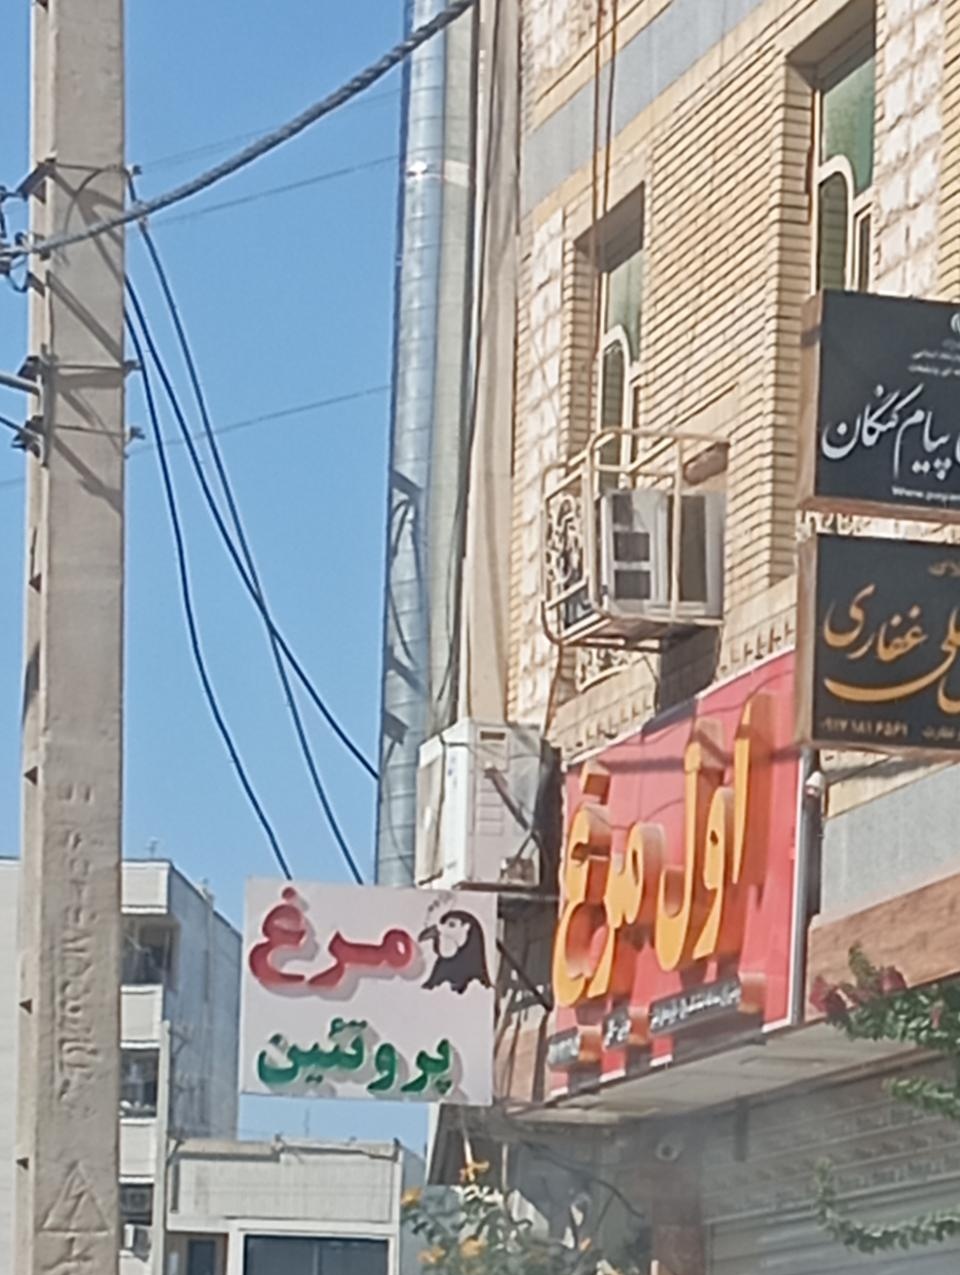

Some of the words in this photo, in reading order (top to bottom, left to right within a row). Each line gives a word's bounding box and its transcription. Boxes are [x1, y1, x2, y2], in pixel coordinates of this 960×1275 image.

[893, 408, 951, 480] پیام
[823, 583, 928, 662] غفاری
[248, 886, 414, 987] مرغ
